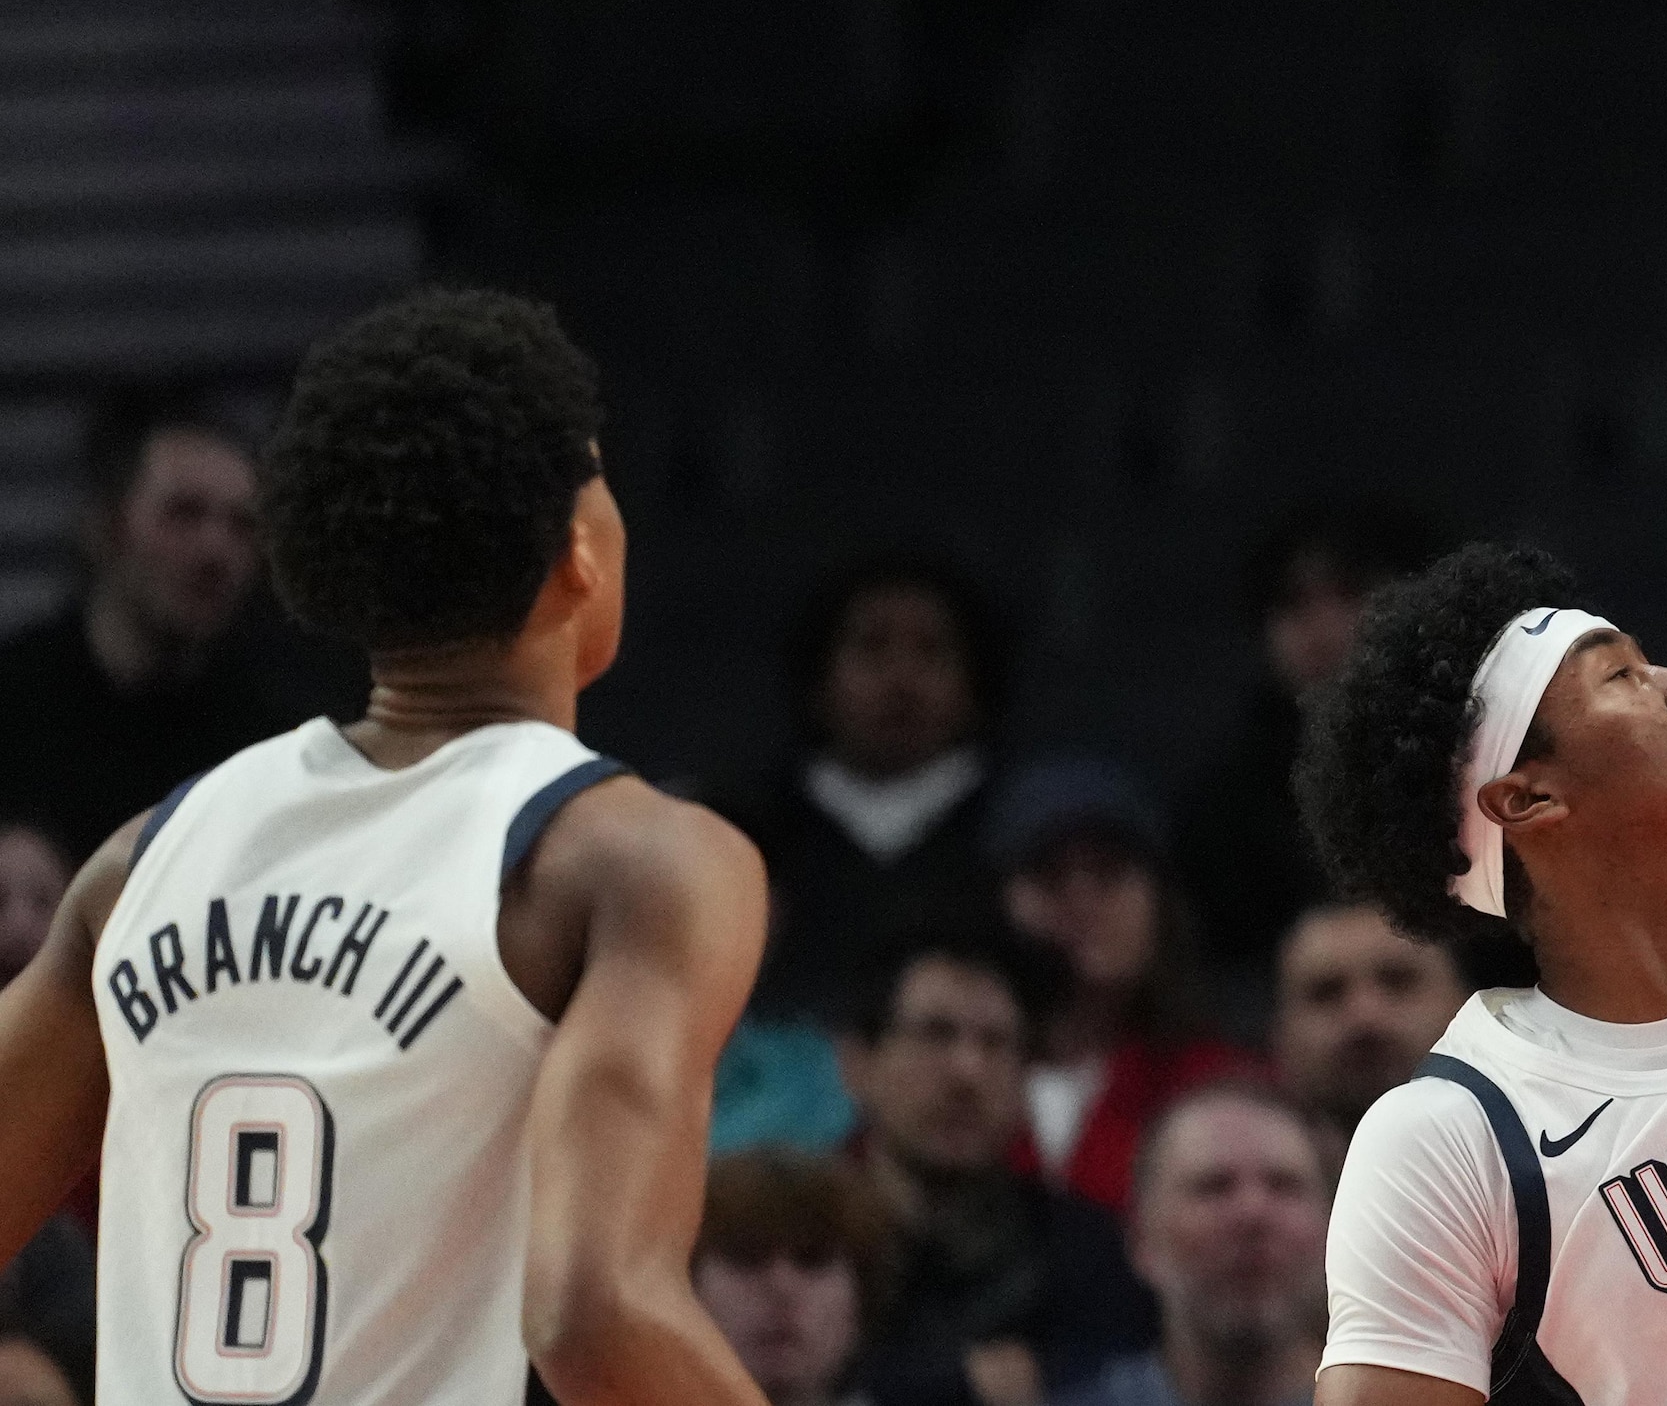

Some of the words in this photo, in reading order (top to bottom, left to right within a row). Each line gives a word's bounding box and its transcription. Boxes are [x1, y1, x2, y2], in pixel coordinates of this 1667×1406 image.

[108, 893, 389, 1045] BRANCH
[374, 938, 465, 1051] III
[173, 1072, 336, 1406] 8
